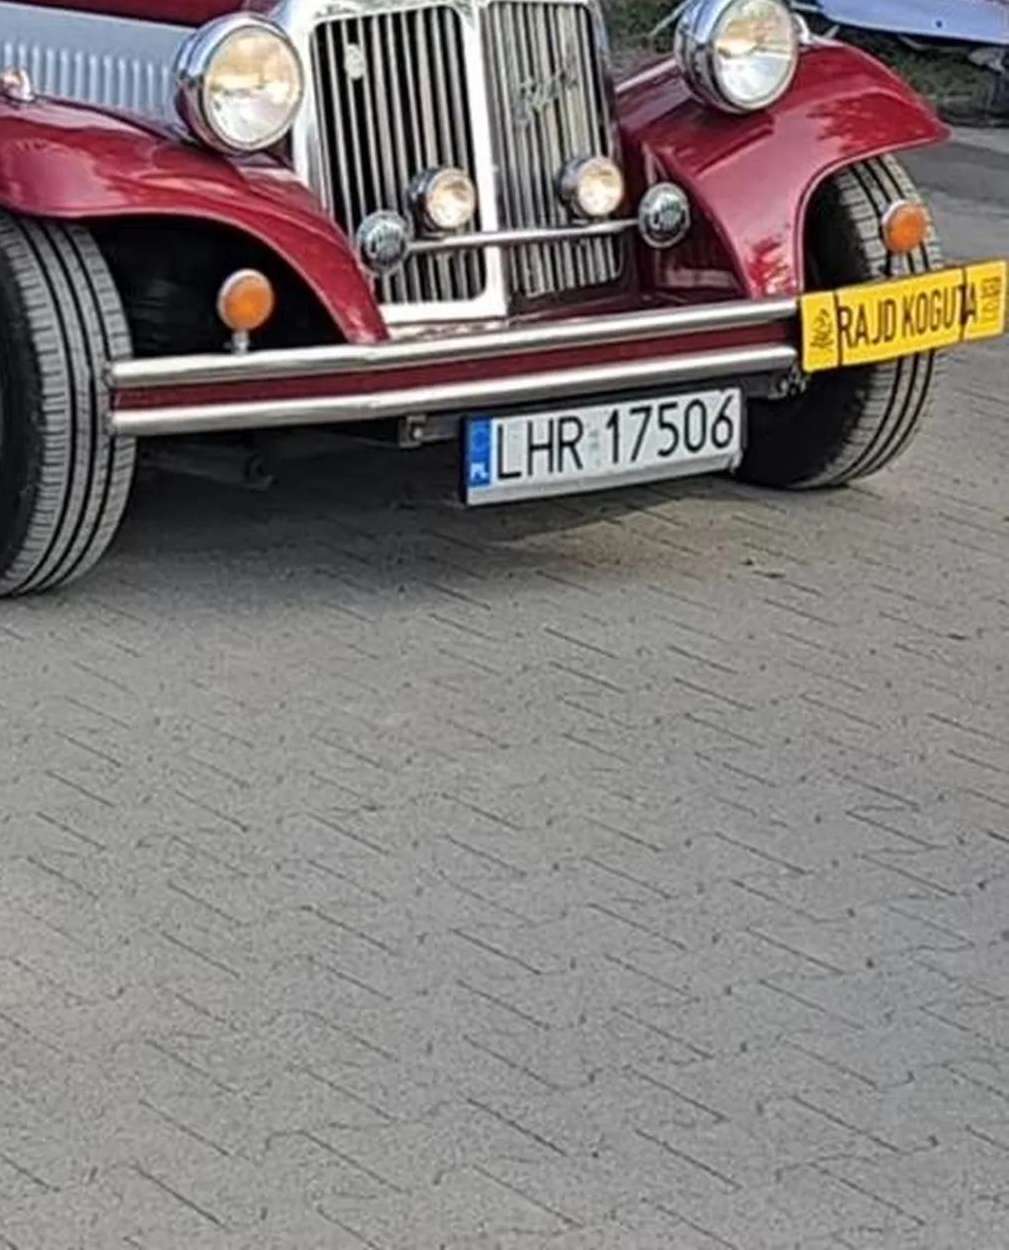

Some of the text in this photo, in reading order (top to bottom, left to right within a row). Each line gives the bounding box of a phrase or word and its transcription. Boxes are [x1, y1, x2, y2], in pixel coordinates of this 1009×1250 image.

[838, 298, 897, 349] RAJD
[902, 282, 978, 340] KOGUTA
[497, 415, 583, 481] LHR
[605, 393, 734, 465] 17506
